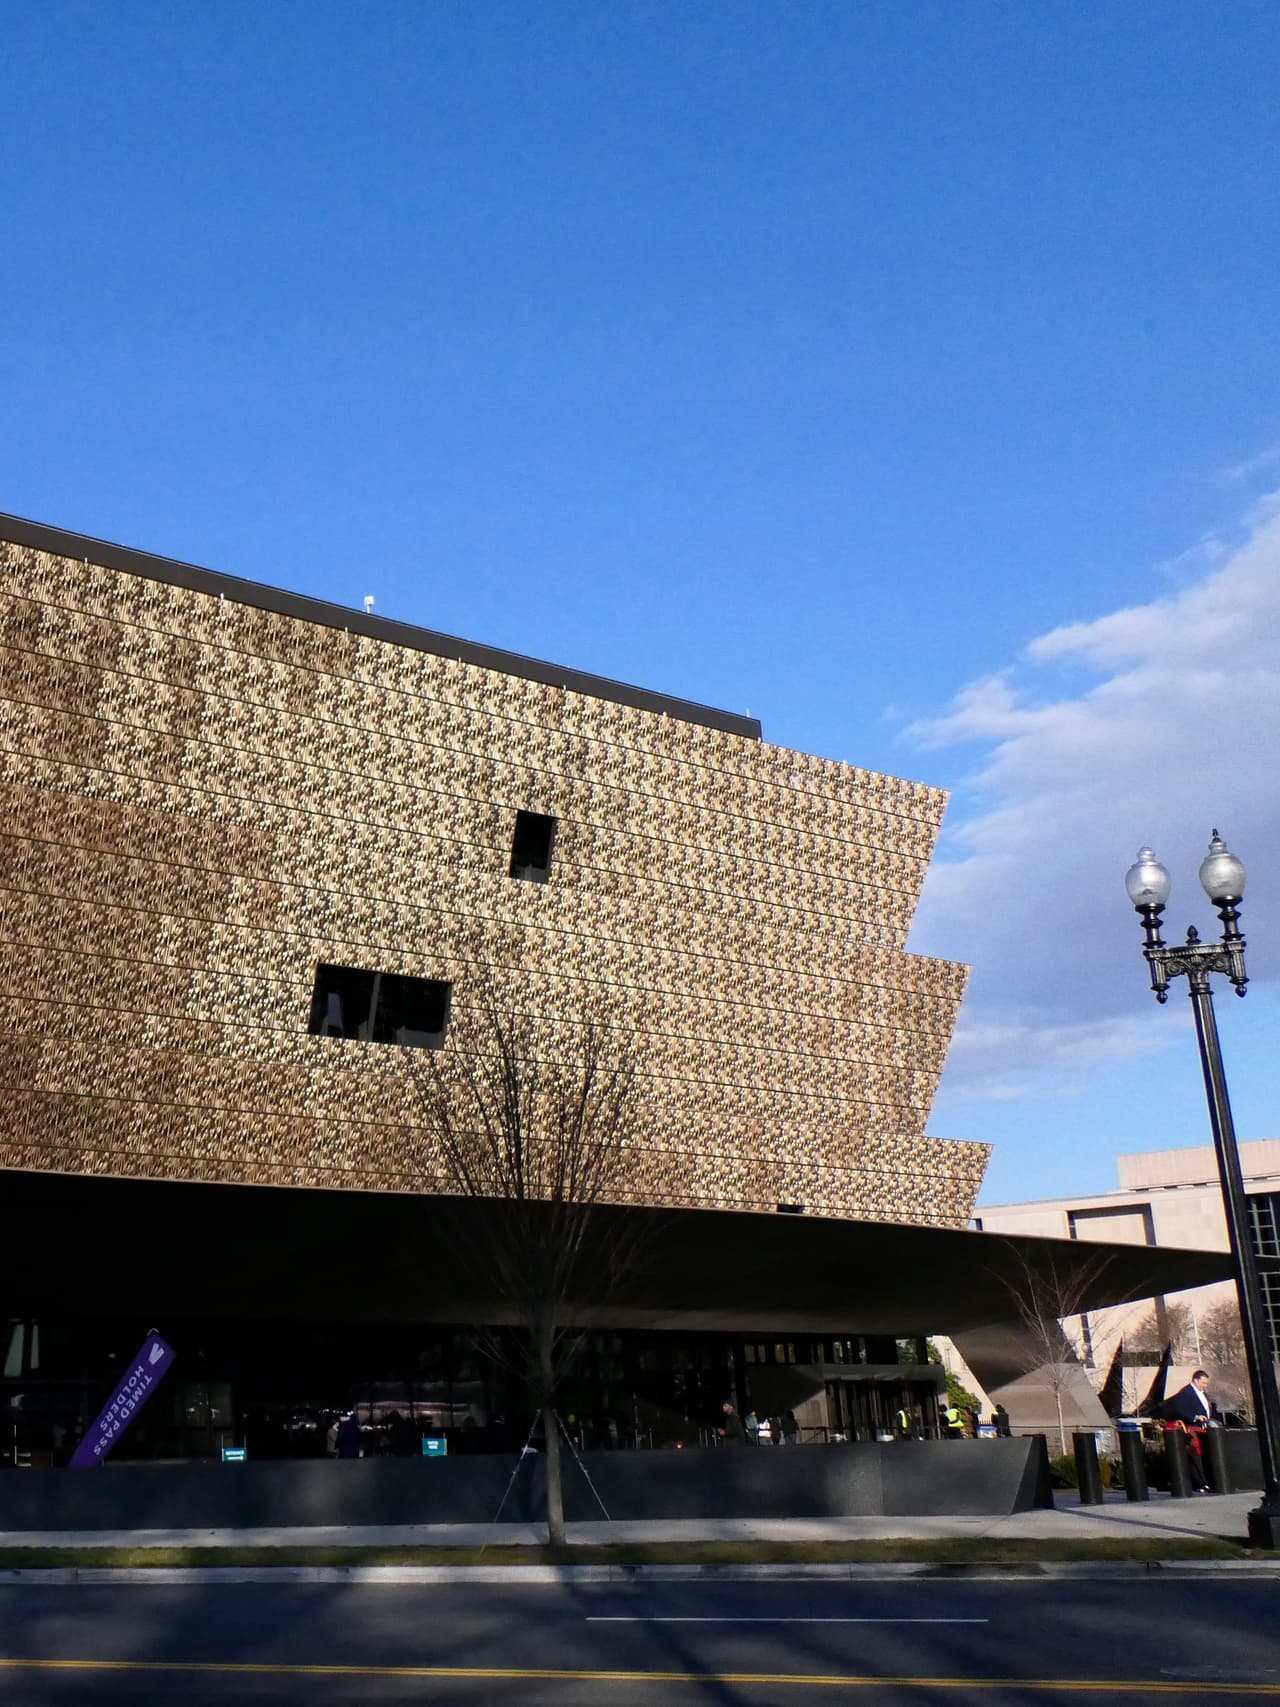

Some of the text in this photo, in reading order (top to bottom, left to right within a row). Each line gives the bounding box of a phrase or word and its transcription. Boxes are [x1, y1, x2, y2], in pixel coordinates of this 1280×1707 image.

[94, 1375, 153, 1455] TIMED PASS
[100, 1366, 145, 1431] HOLDERS
